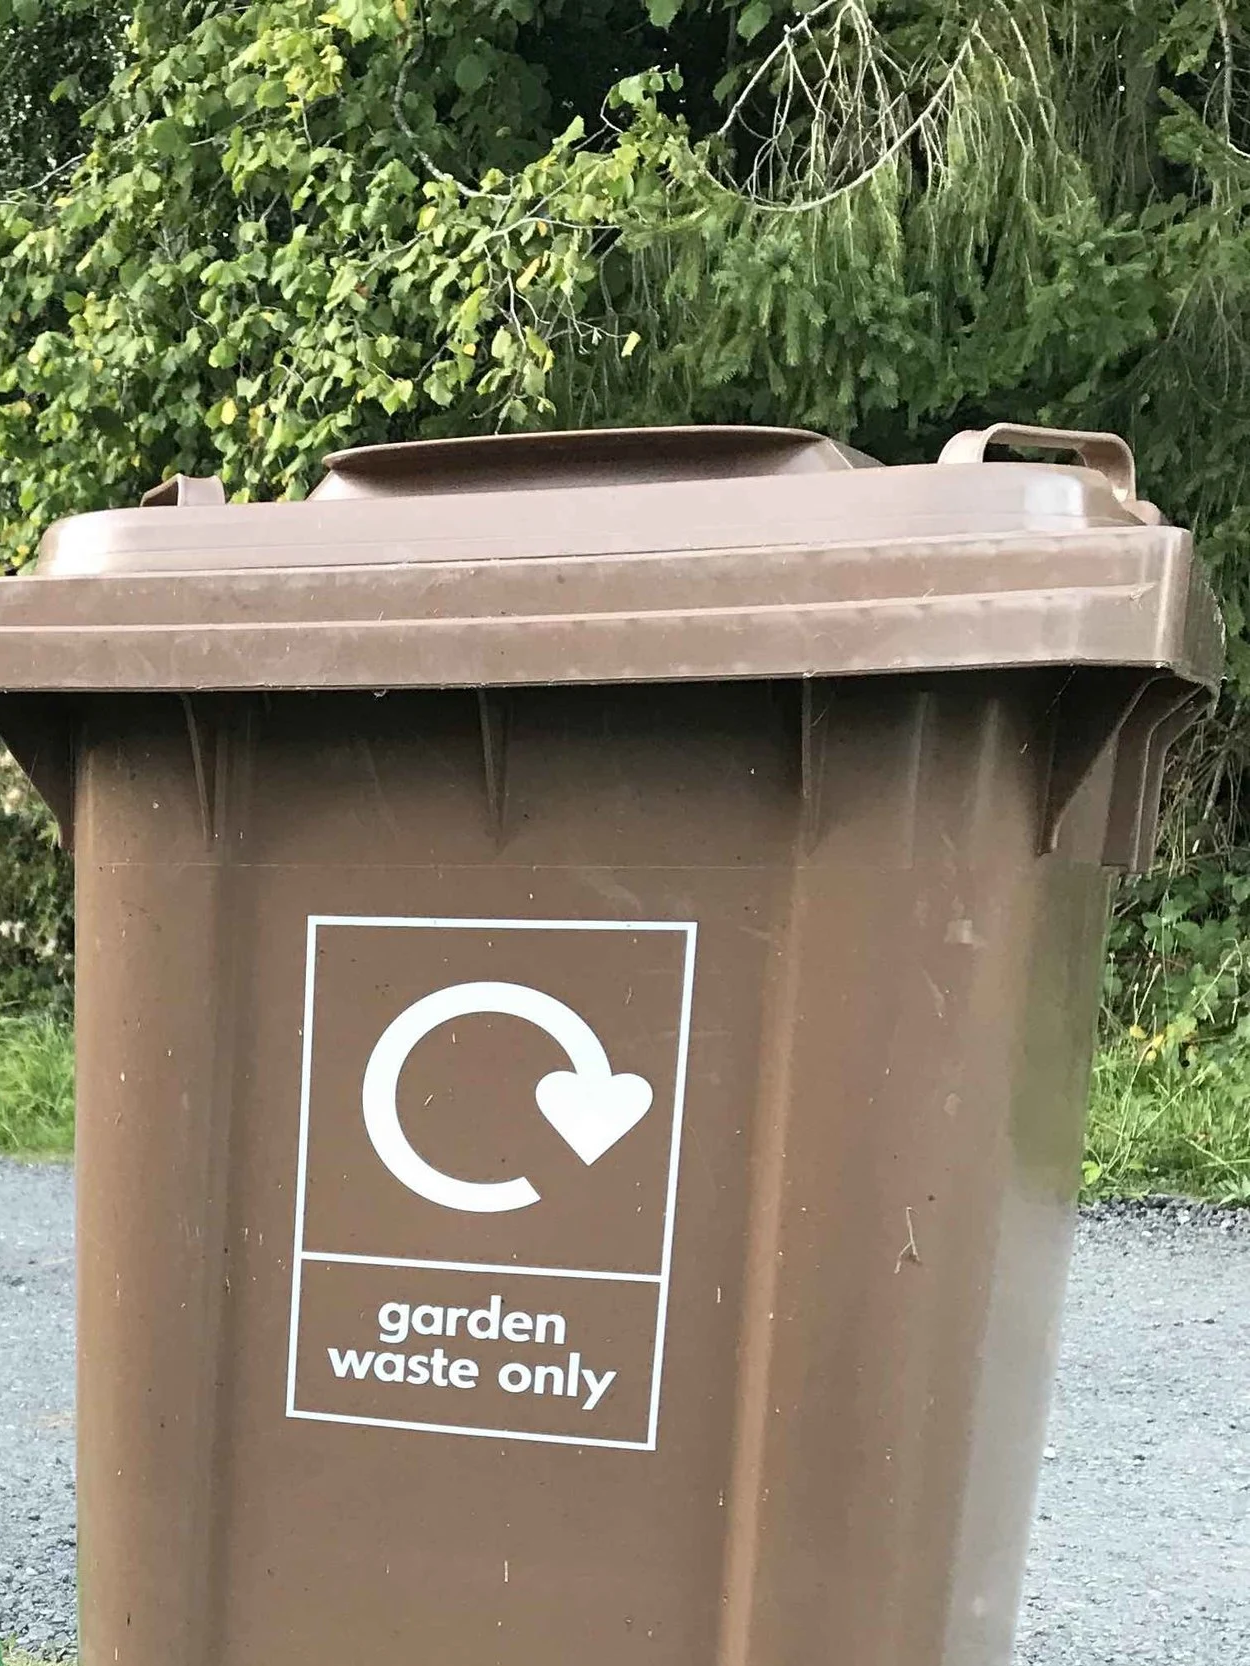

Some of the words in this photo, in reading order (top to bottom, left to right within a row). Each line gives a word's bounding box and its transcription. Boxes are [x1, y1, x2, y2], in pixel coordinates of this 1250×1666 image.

[378, 1295, 566, 1344] garden
[327, 1348, 479, 1389] waste
[498, 1352, 617, 1410] only
